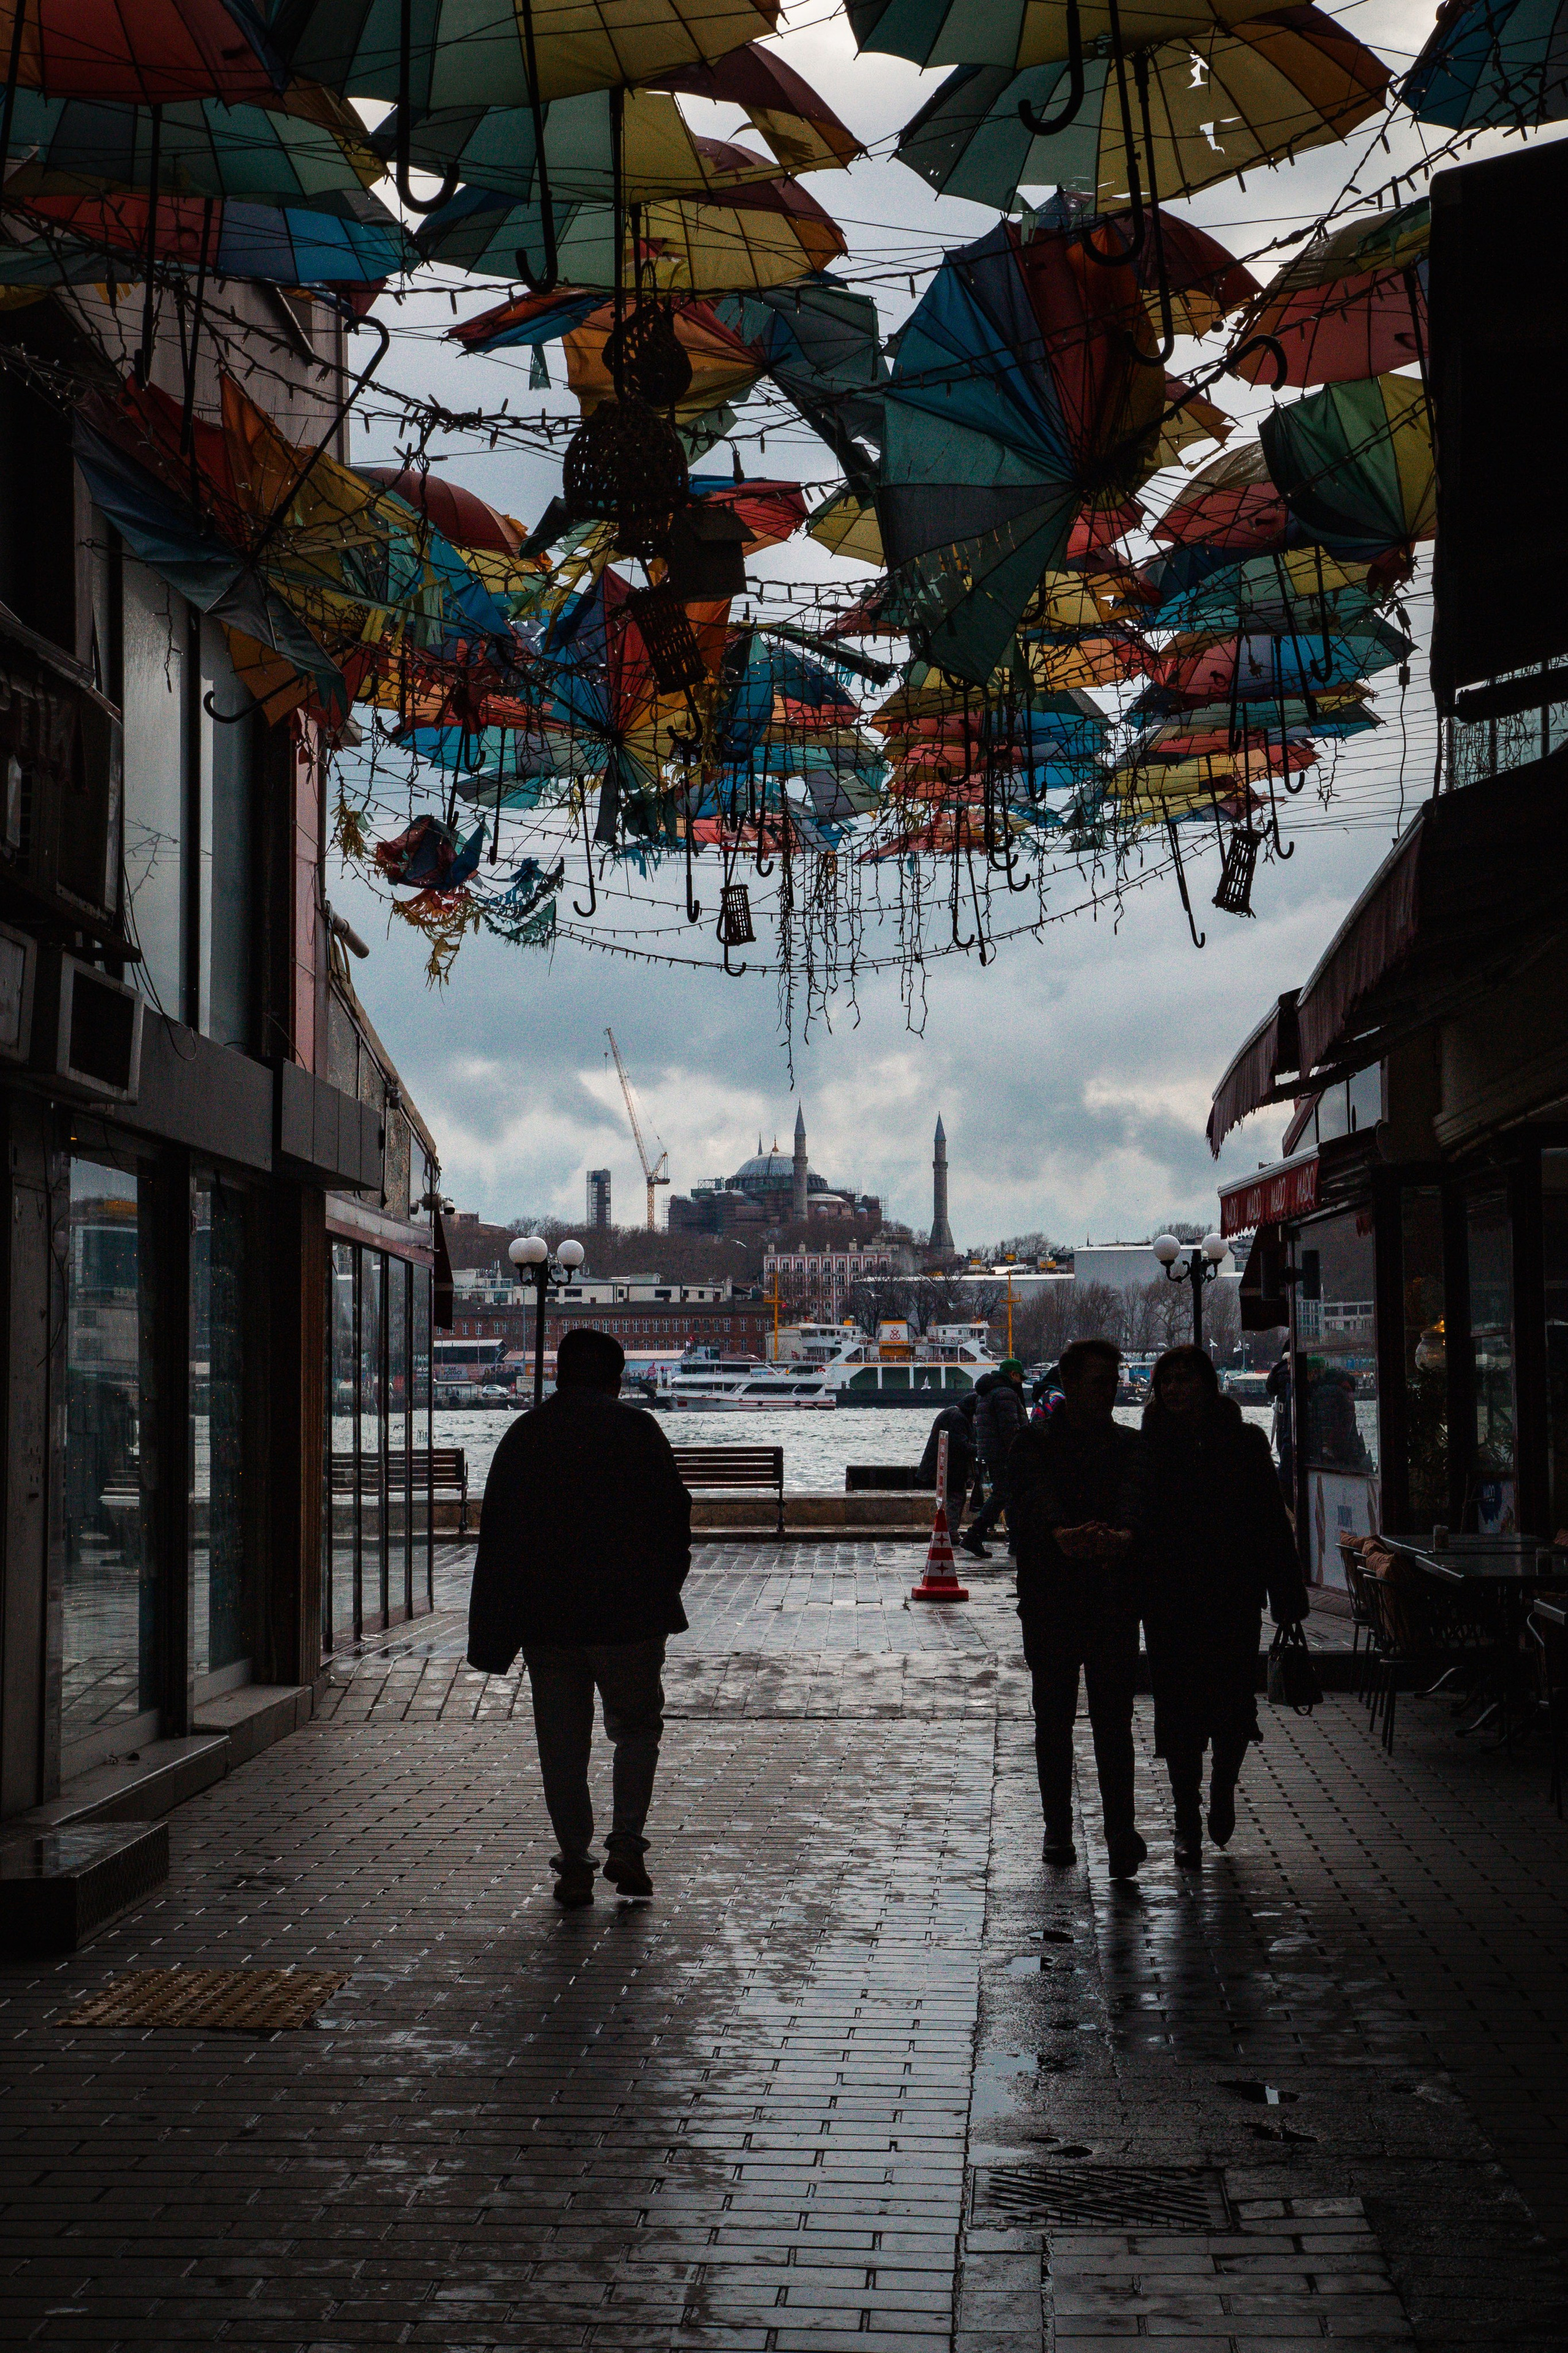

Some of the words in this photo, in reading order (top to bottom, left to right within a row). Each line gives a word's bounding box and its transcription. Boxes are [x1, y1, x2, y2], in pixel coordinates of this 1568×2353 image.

[1246, 1187, 1261, 1222] MADO
[1271, 1176, 1286, 1213] MADO
[1297, 1165, 1315, 1204] MADO
